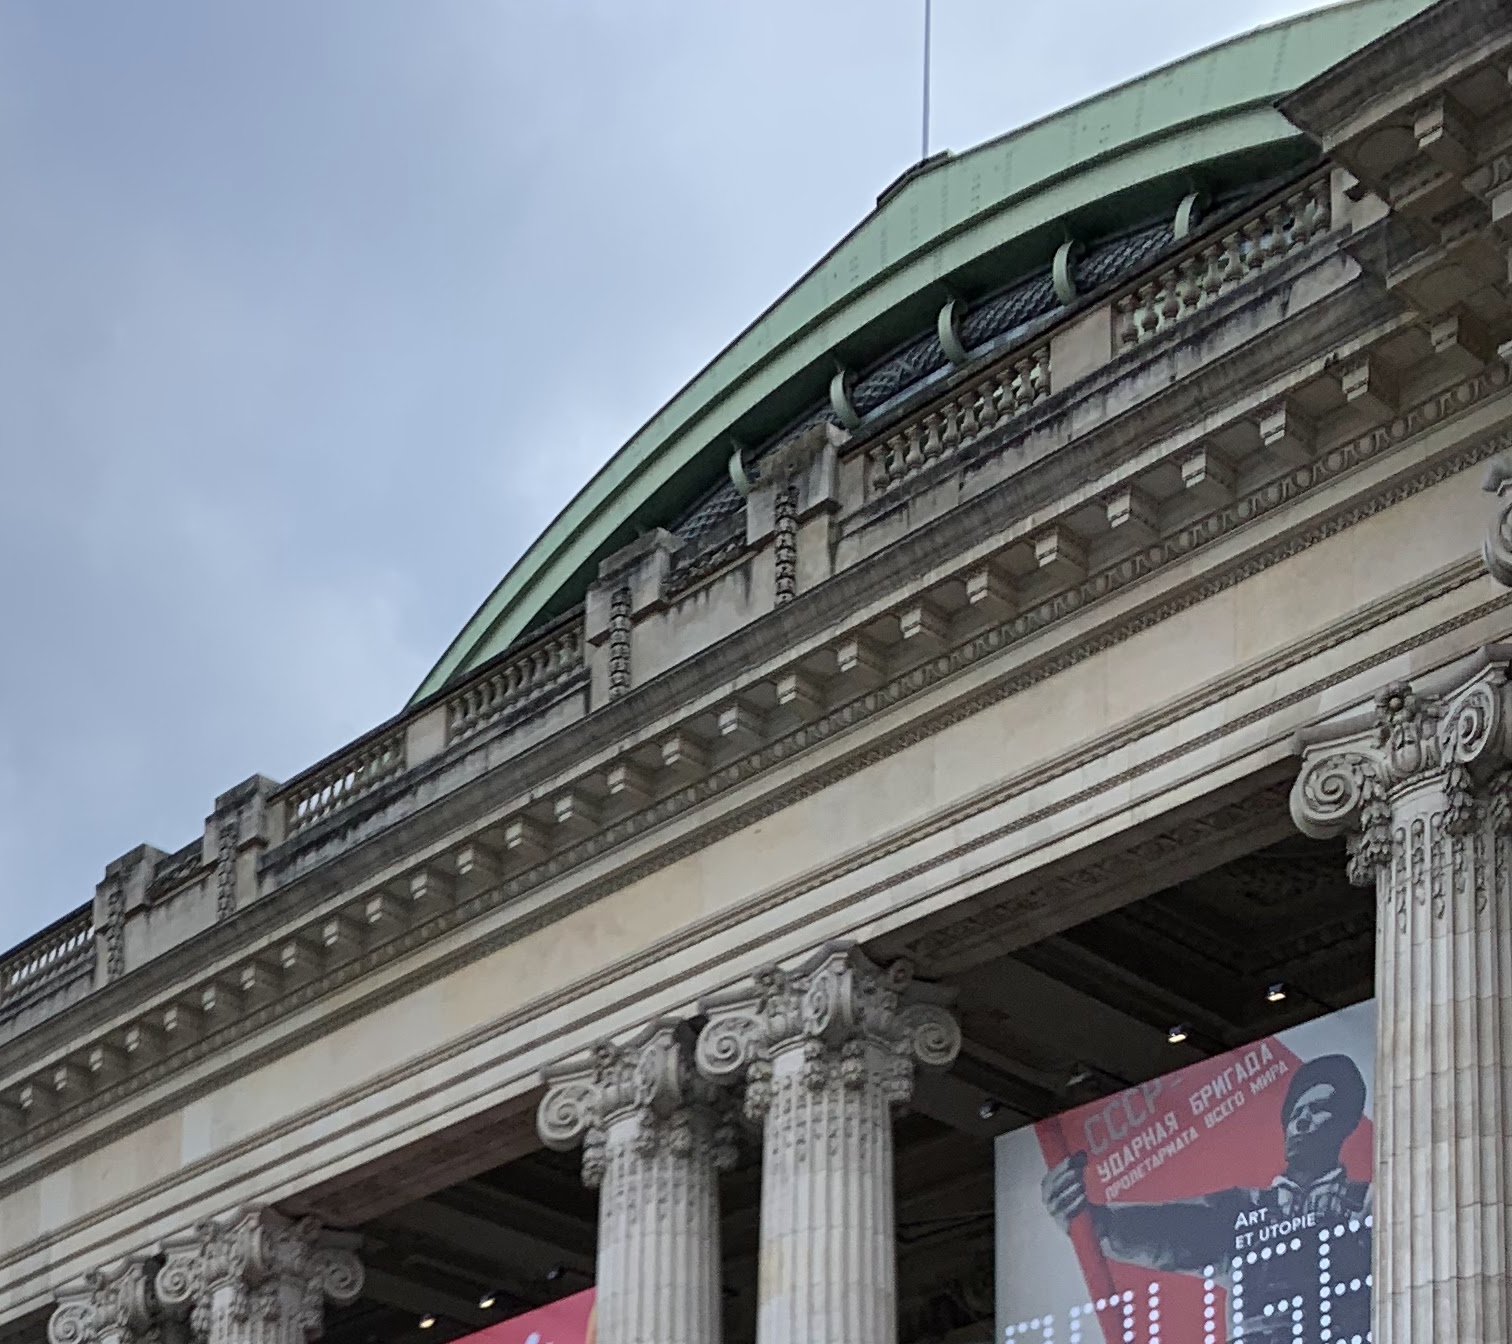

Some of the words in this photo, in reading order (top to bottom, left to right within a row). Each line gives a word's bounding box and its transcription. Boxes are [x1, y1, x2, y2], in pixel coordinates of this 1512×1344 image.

[1249, 1060, 1289, 1095] МИРА
[1097, 1111, 1179, 1183] УДАРНАЯ
[1189, 1042, 1273, 1116] БРИГАДА
[1235, 1207, 1268, 1230] ART
[1235, 1232, 1254, 1249] ET
[1259, 1212, 1317, 1242] UTOPIE
